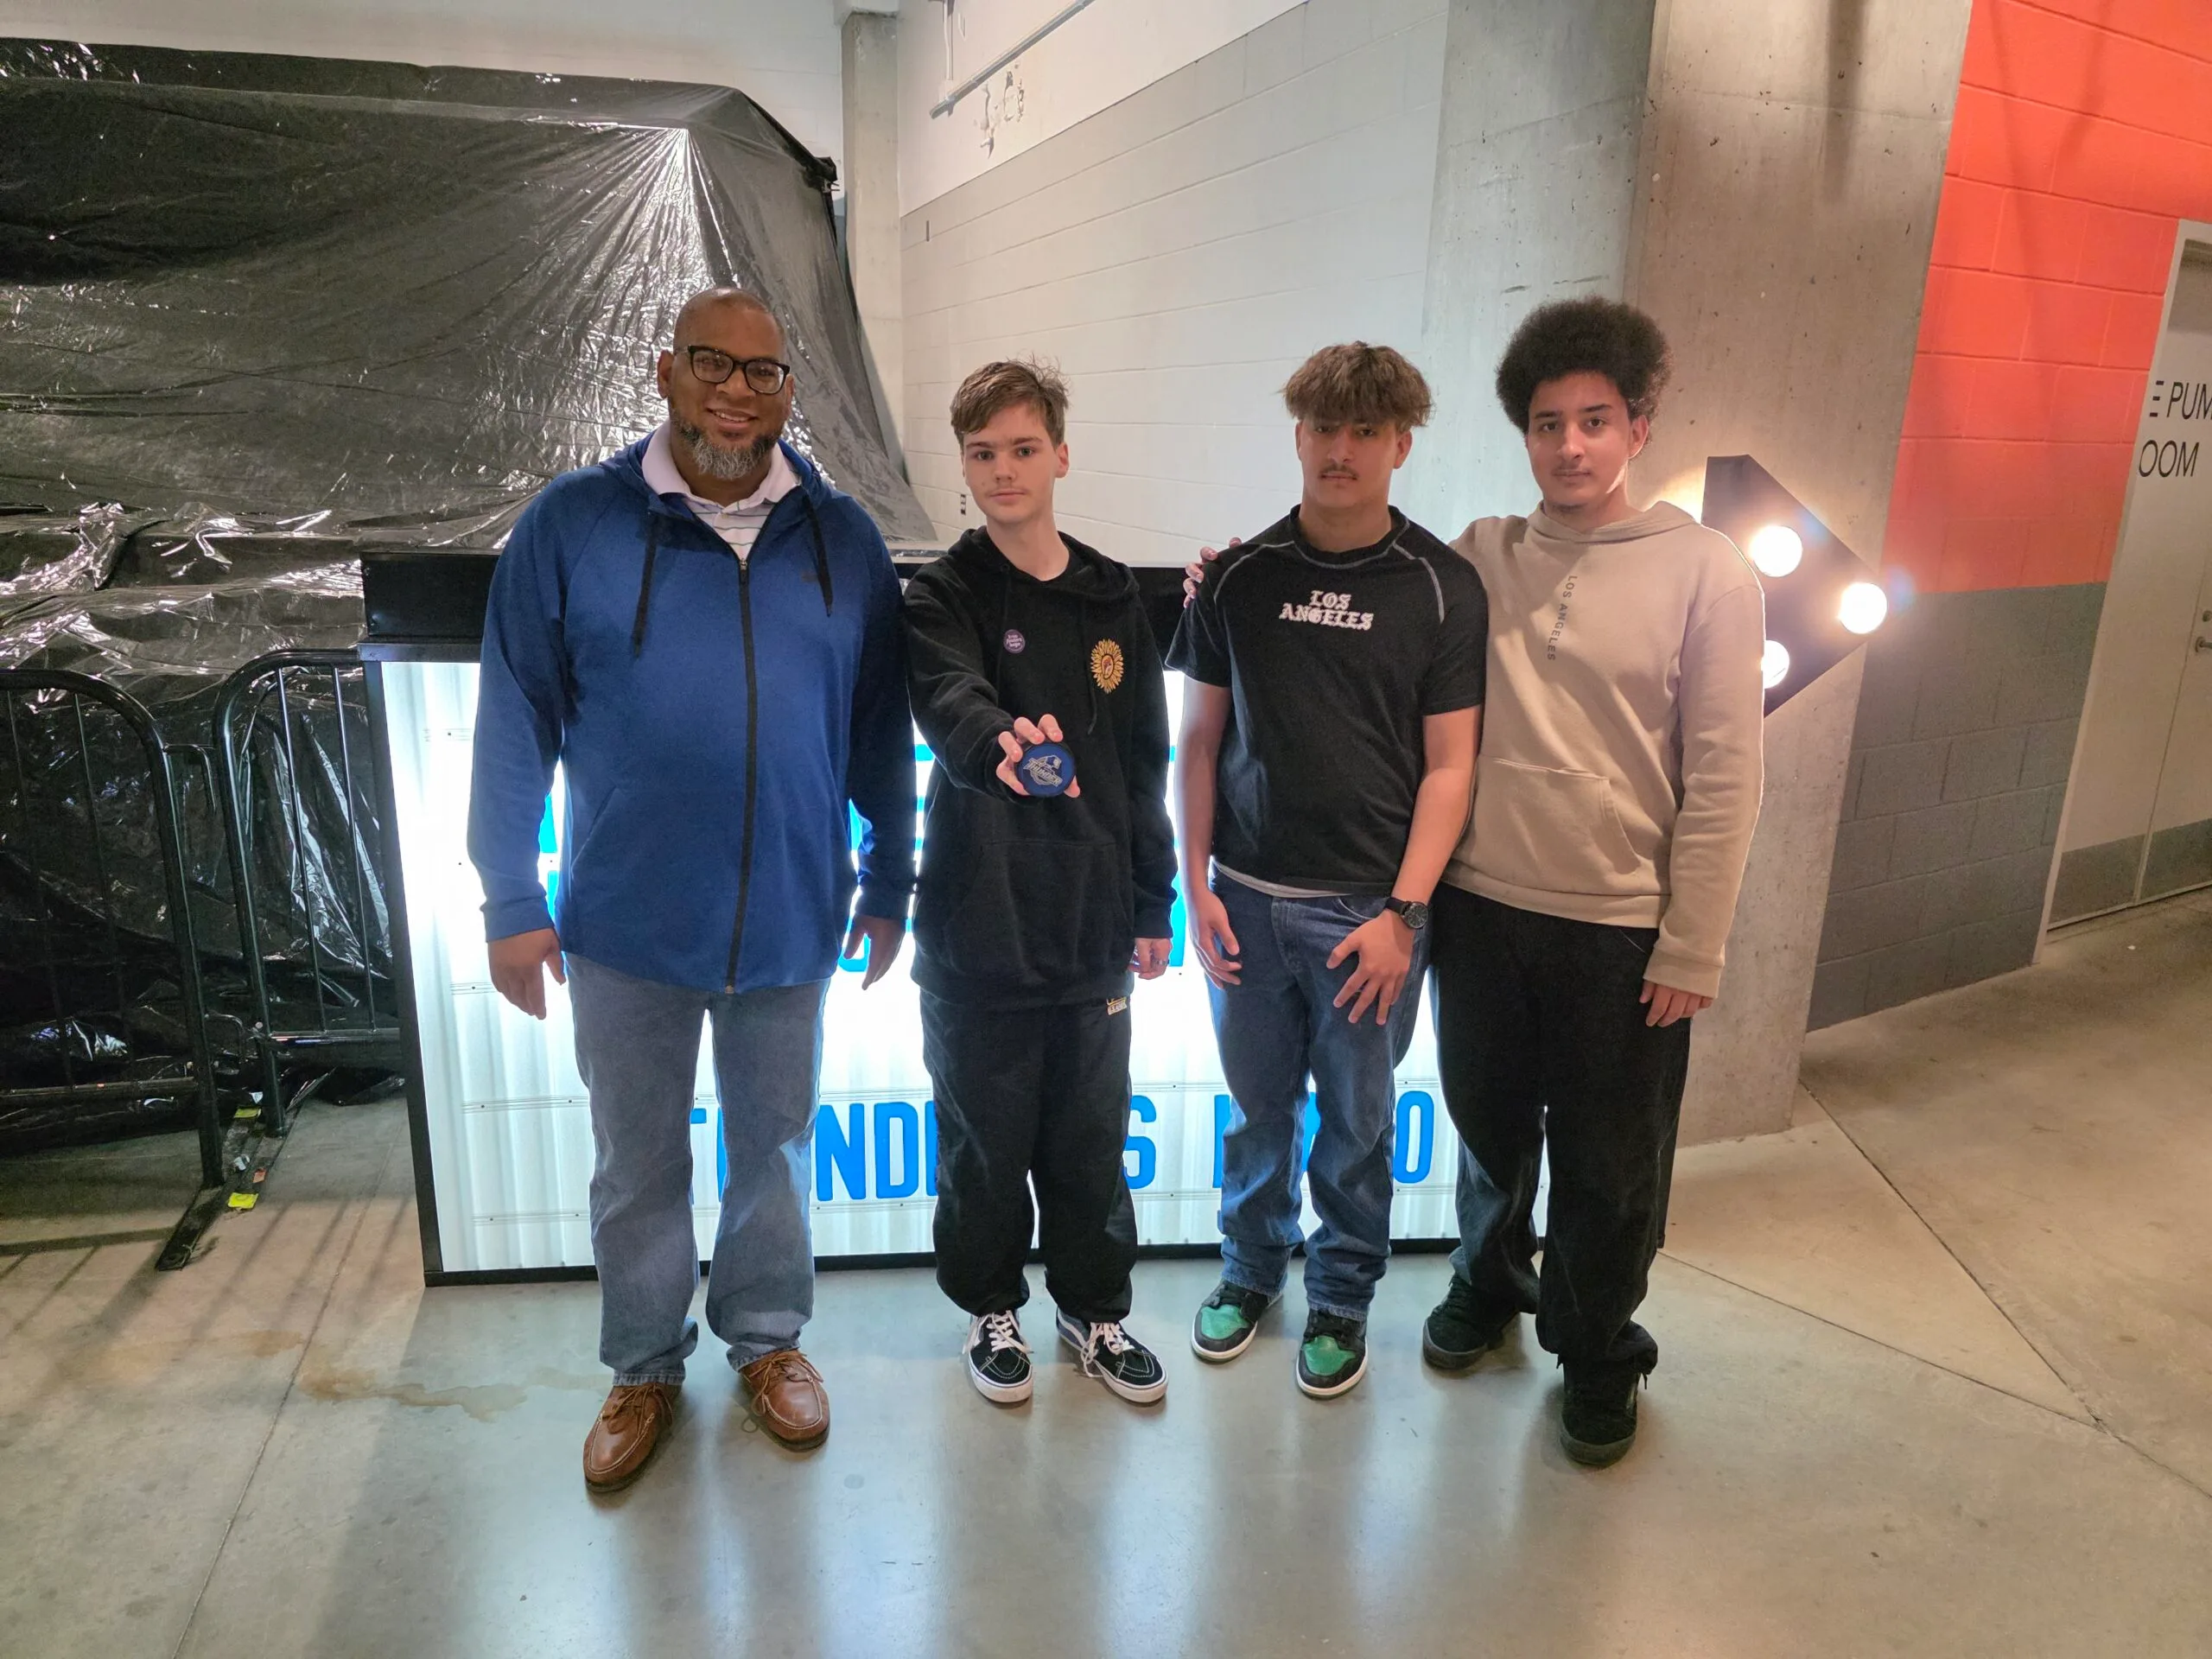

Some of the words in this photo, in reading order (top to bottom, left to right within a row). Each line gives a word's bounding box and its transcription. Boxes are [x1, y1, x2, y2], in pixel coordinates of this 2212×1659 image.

[1309, 589, 1352, 610] LOS
[1279, 602, 1375, 631] ANGELES
[1547, 603, 1568, 661] ANGELES
[1023, 758, 1064, 787] THUNDER
